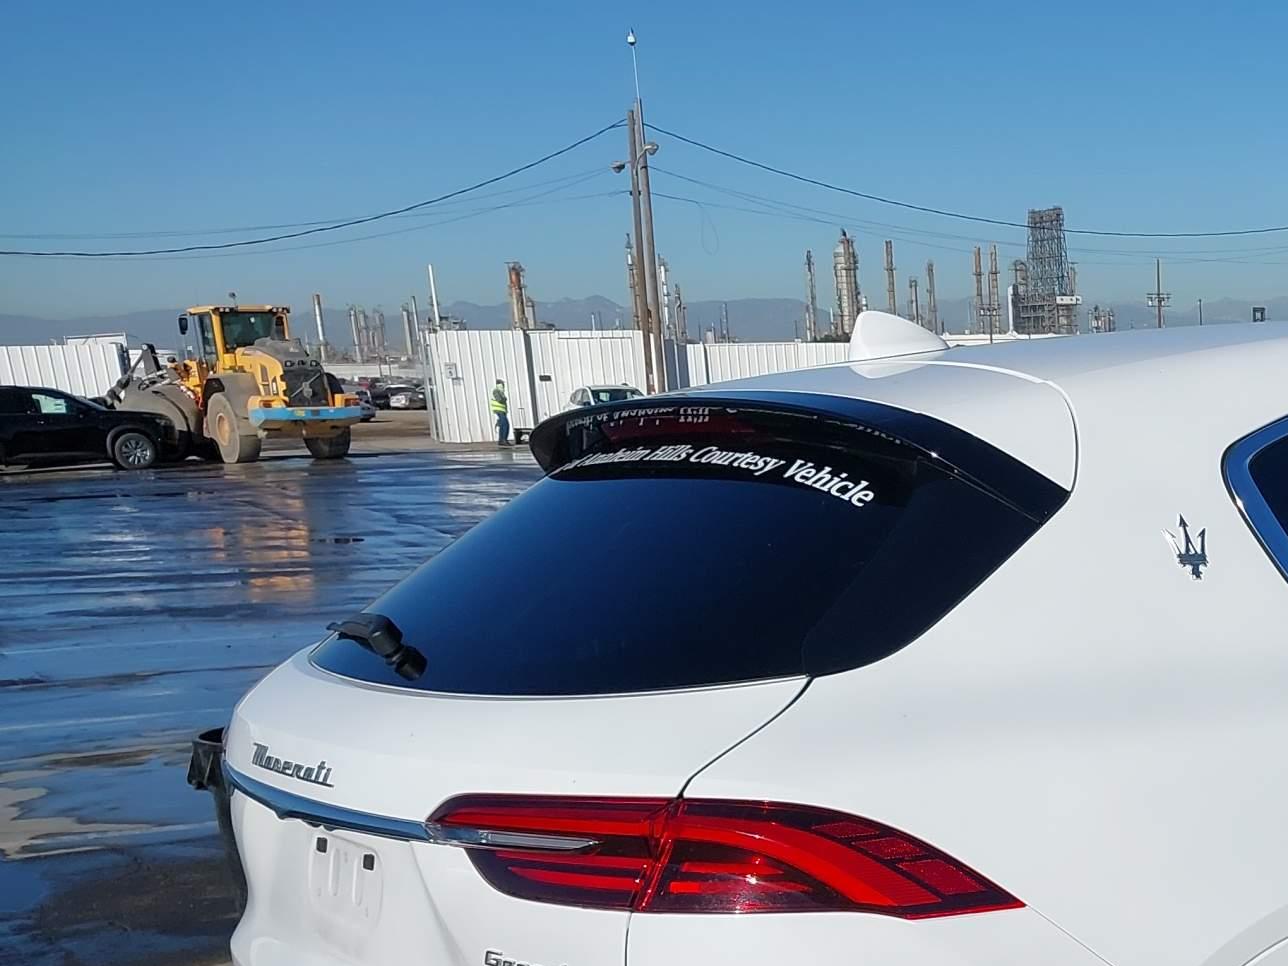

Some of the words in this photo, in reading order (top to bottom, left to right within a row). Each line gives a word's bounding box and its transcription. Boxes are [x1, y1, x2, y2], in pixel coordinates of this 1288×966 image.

[643, 444, 694, 461] Hills
[689, 446, 786, 476] Courtesy
[783, 459, 875, 507] Vehicle
[252, 742, 334, 788] Maserati
